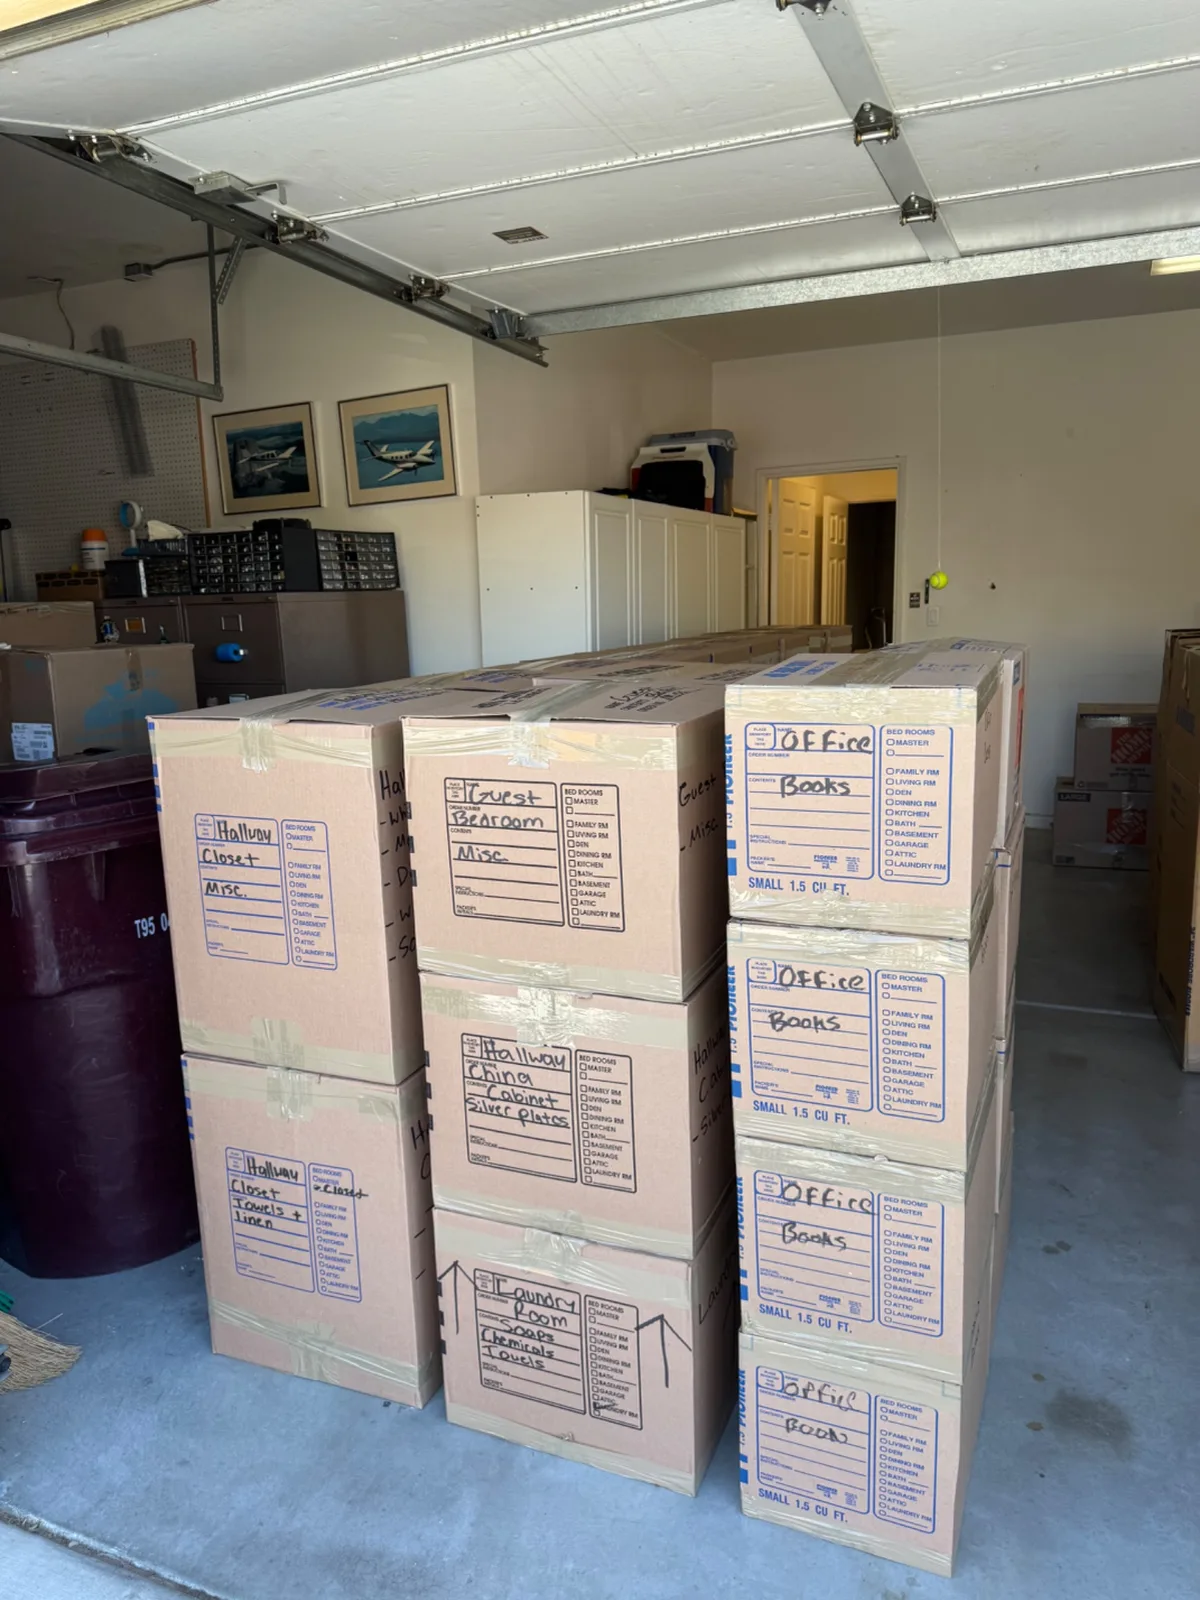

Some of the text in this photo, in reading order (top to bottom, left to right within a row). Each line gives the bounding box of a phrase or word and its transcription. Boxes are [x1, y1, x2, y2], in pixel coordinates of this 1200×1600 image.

[679, 773, 716, 806] Guest
[780, 775, 851, 798] Books
[469, 783, 541, 804] Guest
[453, 810, 543, 829] Bedroom
[895, 830, 938, 838] BASEMENT
[203, 849, 259, 866] Closet
[895, 861, 933, 869] LAUNDRY
[749, 877, 783, 890] SMALL
[790, 880, 805, 892] 1.5
[580, 909, 608, 917] LAUNDRY
[134, 916, 155, 938] T95
[891, 984, 923, 992] MASTER
[769, 1011, 840, 1033] Books
[891, 1020, 916, 1028] LIVING
[891, 1039, 917, 1048] DINING
[484, 1039, 565, 1069] Hallway
[892, 1049, 924, 1058] KITCHEN
[593, 1057, 616, 1065] ROOMS
[588, 1065, 611, 1073] MASTER
[892, 1068, 933, 1079] BASEMENT
[469, 1064, 533, 1086] China
[892, 1077, 925, 1087] GARAGE
[487, 1084, 558, 1108] Cabinet
[589, 1086, 609, 1095] FAMILY
[892, 1087, 913, 1095] ATTIC
[589, 1096, 610, 1104] LIVING
[892, 1096, 928, 1107] LAUNDRY
[465, 1098, 510, 1116] Silver
[753, 1100, 850, 1125] SMALL 1.5 CU FT.
[590, 1115, 612, 1123] DINING
[590, 1124, 616, 1132] KITCHEN
[591, 1142, 622, 1151] BASEMENT
[591, 1151, 618, 1160] GARAGE
[246, 1156, 298, 1181] Hallway
[592, 1168, 620, 1178] LAUNDRY
[231, 1179, 280, 1199] Closet
[323, 1184, 369, 1199] Closet
[233, 1198, 284, 1216] Towels
[901, 1199, 928, 1208] ROOMS
[892, 1207, 922, 1216] MASTER
[783, 1221, 847, 1252] Books
[893, 1232, 919, 1241] FAMILY
[893, 1240, 916, 1249] LIVING
[893, 1258, 917, 1267] DINING
[893, 1267, 924, 1278] KITCHEN
[893, 1276, 912, 1284] BATH
[496, 1278, 575, 1313] Laundry
[893, 1285, 932, 1297] BASEMENT
[893, 1293, 924, 1304] GARAGE
[893, 1302, 913, 1310] ATTIC
[514, 1303, 567, 1327] Room
[760, 1304, 852, 1333] SMALL 1.5 CU FT.
[892, 1310, 926, 1322] LAUNDRY
[500, 1319, 555, 1342] Soaps
[481, 1329, 554, 1358] Chemicals
[482, 1345, 545, 1369] Towels
[759, 1488, 848, 1523] SMALL 1.5 CU FT.
